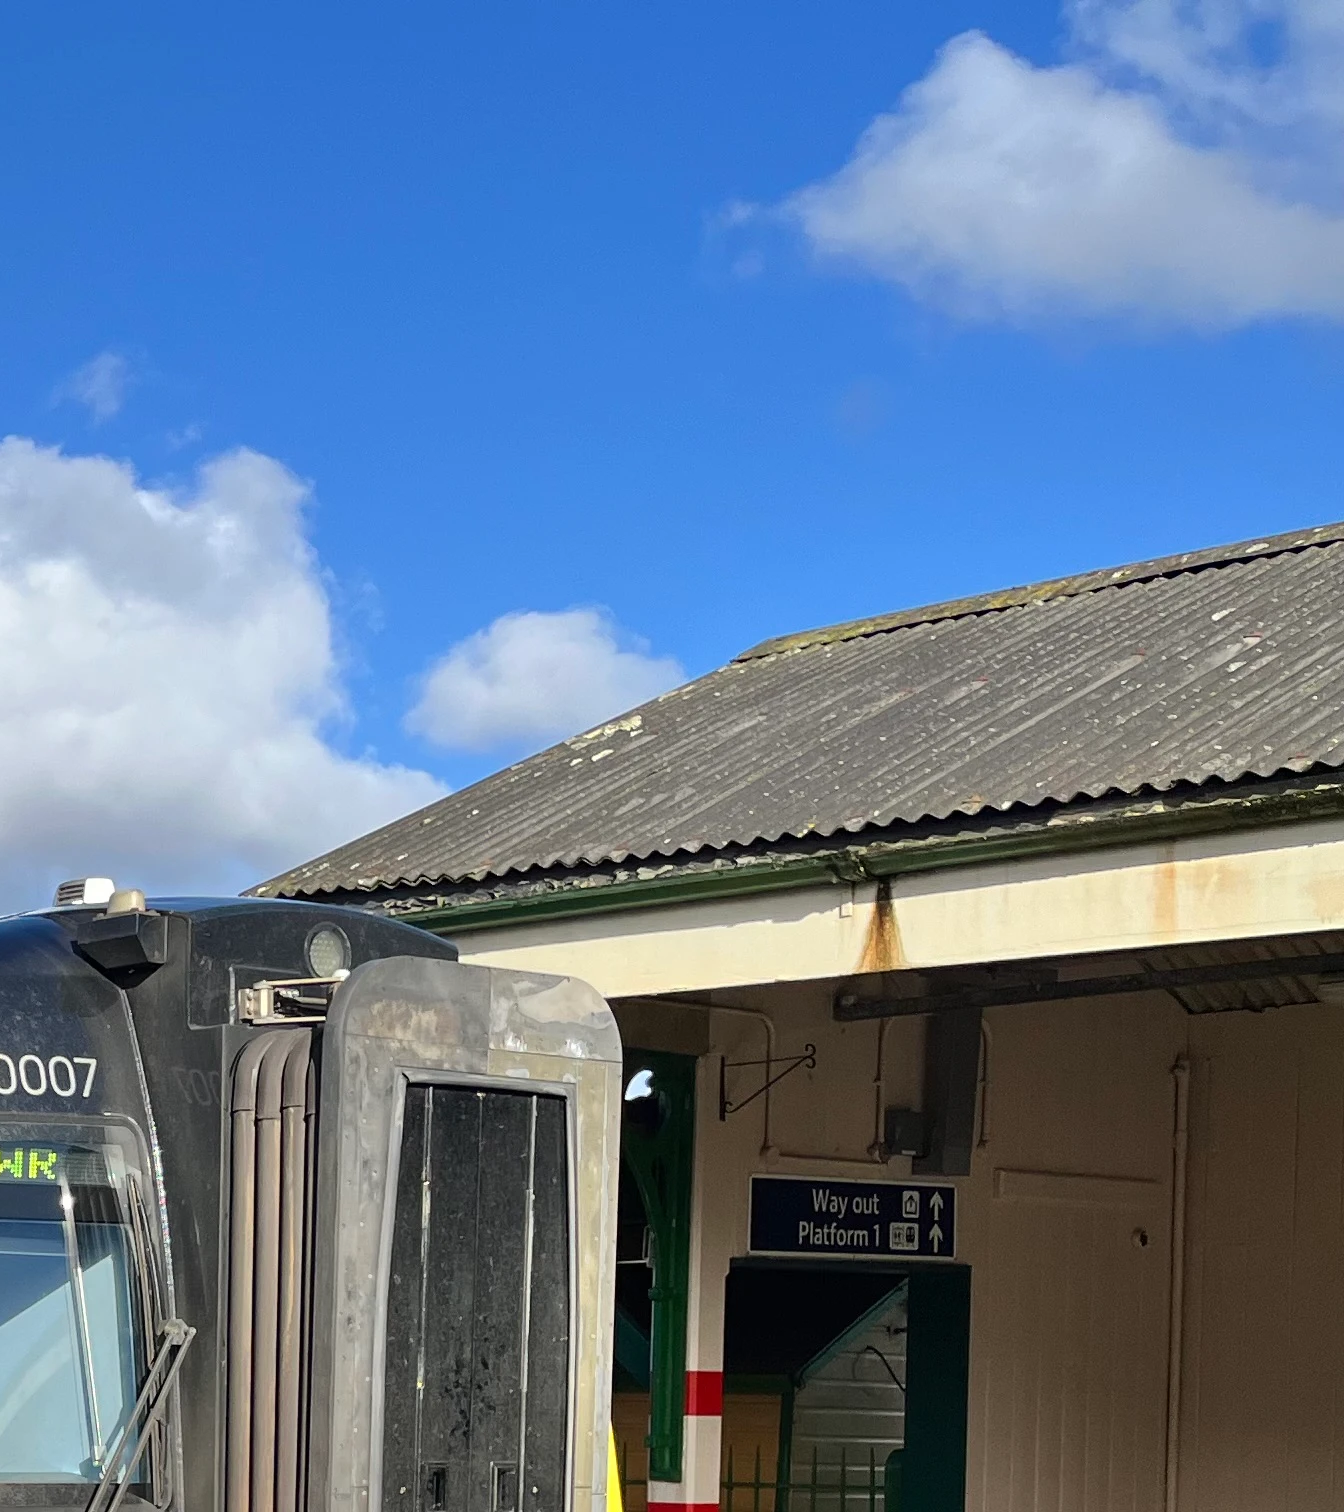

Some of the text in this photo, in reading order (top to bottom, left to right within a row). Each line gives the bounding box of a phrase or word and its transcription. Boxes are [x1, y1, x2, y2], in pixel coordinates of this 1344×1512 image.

[812, 1189, 880, 1219] Way out
[798, 1221, 881, 1247] Platform 1
